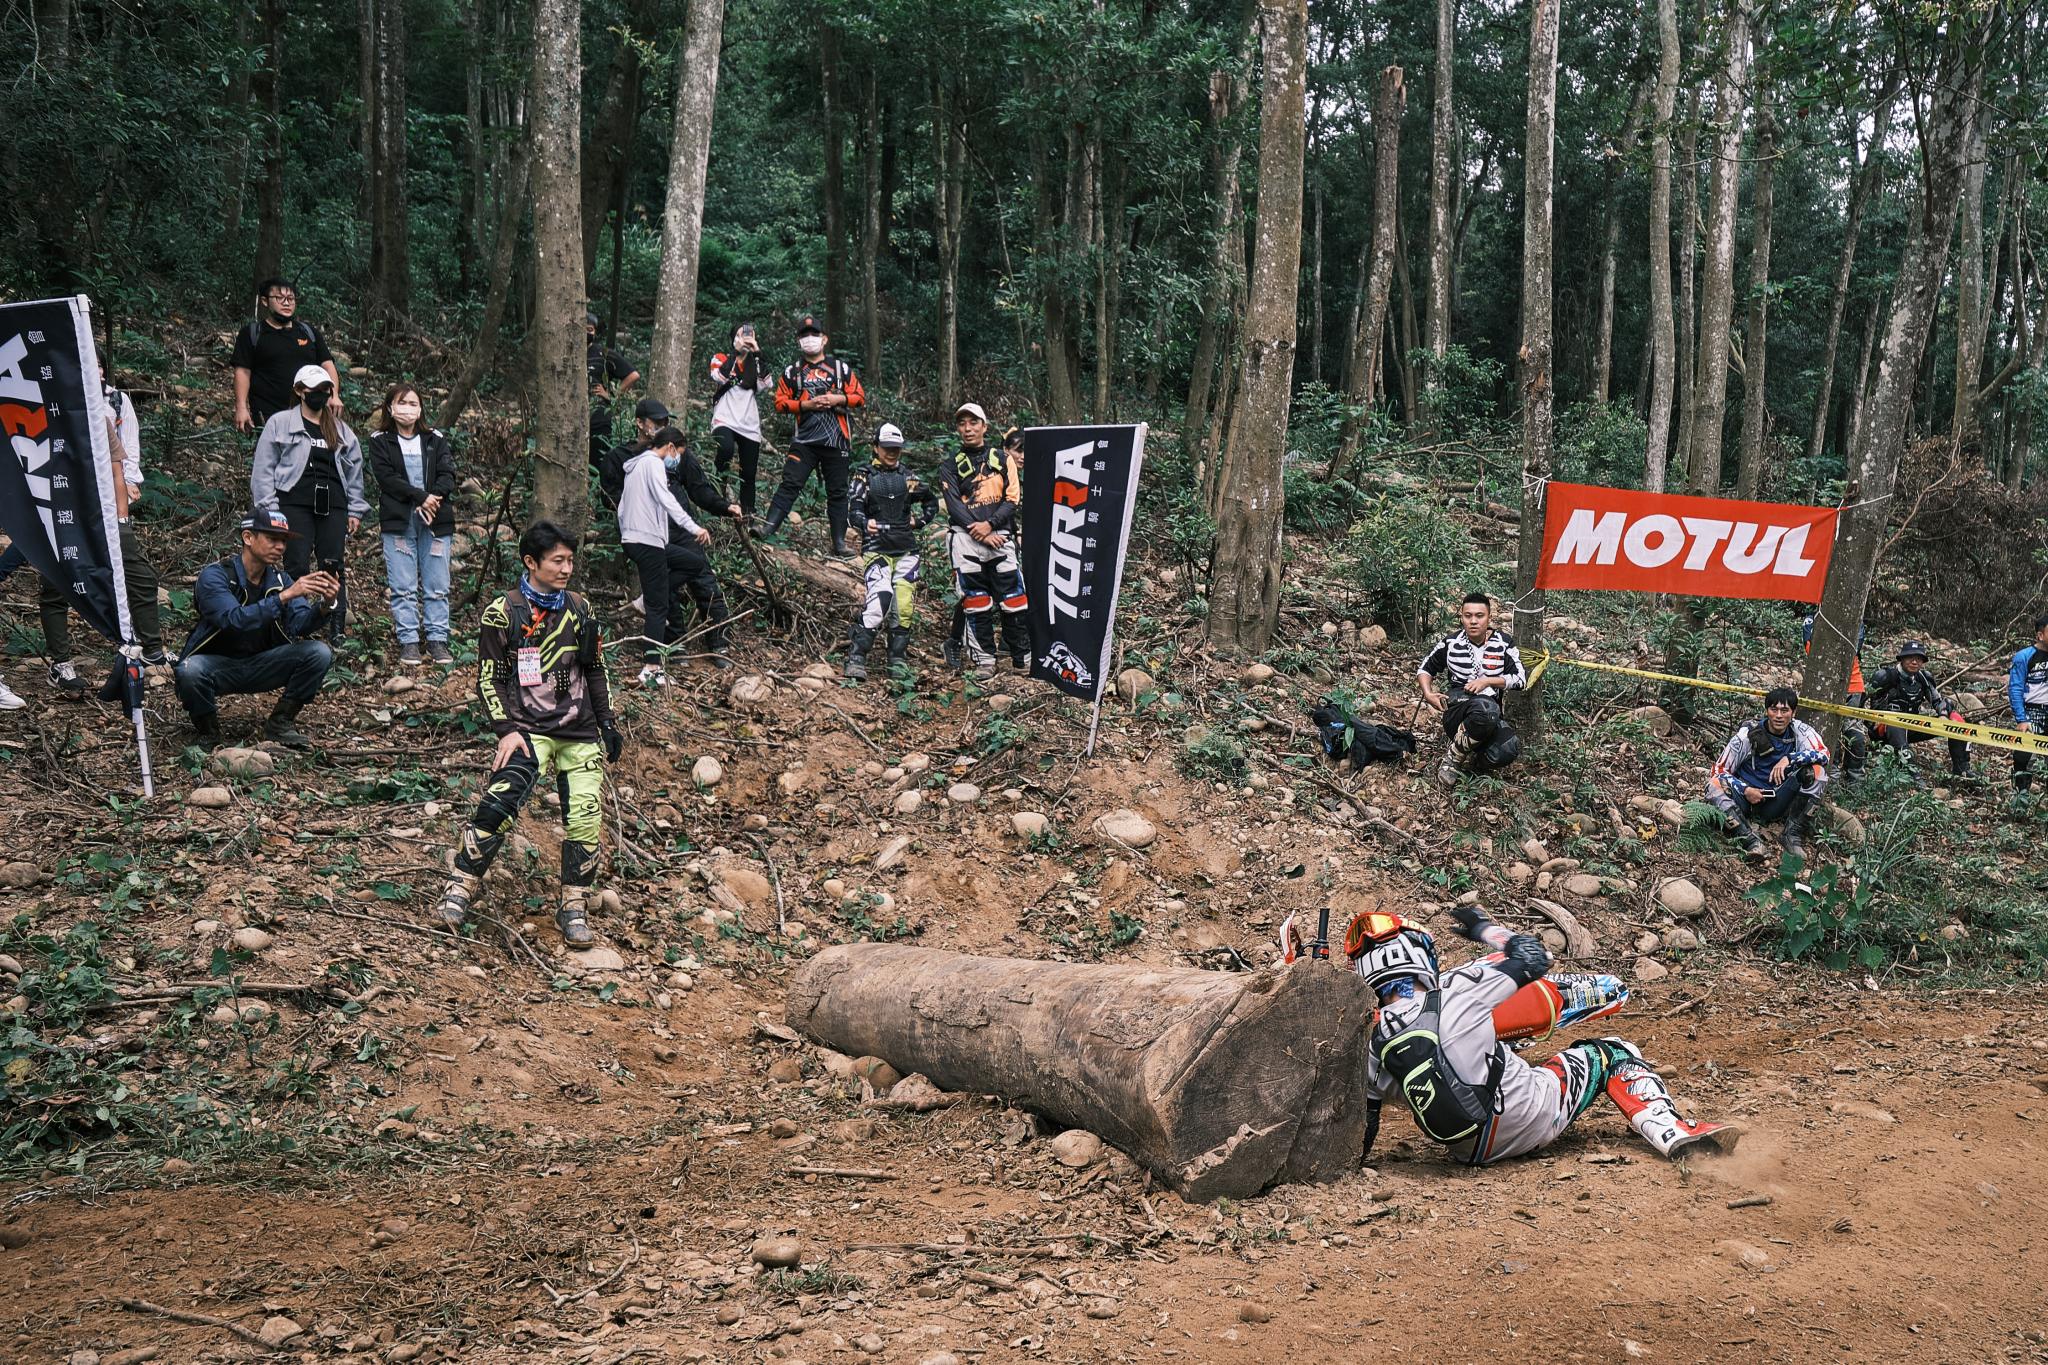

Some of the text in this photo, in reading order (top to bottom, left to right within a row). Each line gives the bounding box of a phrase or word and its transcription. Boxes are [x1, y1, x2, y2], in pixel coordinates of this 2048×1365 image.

[28, 330, 87, 595] 台灣越野騎士協會
[1048, 440, 1095, 624] TORRA
[1081, 440, 1109, 619] 台灣越野騎士協會
[1551, 509, 1816, 577] MOTUL
